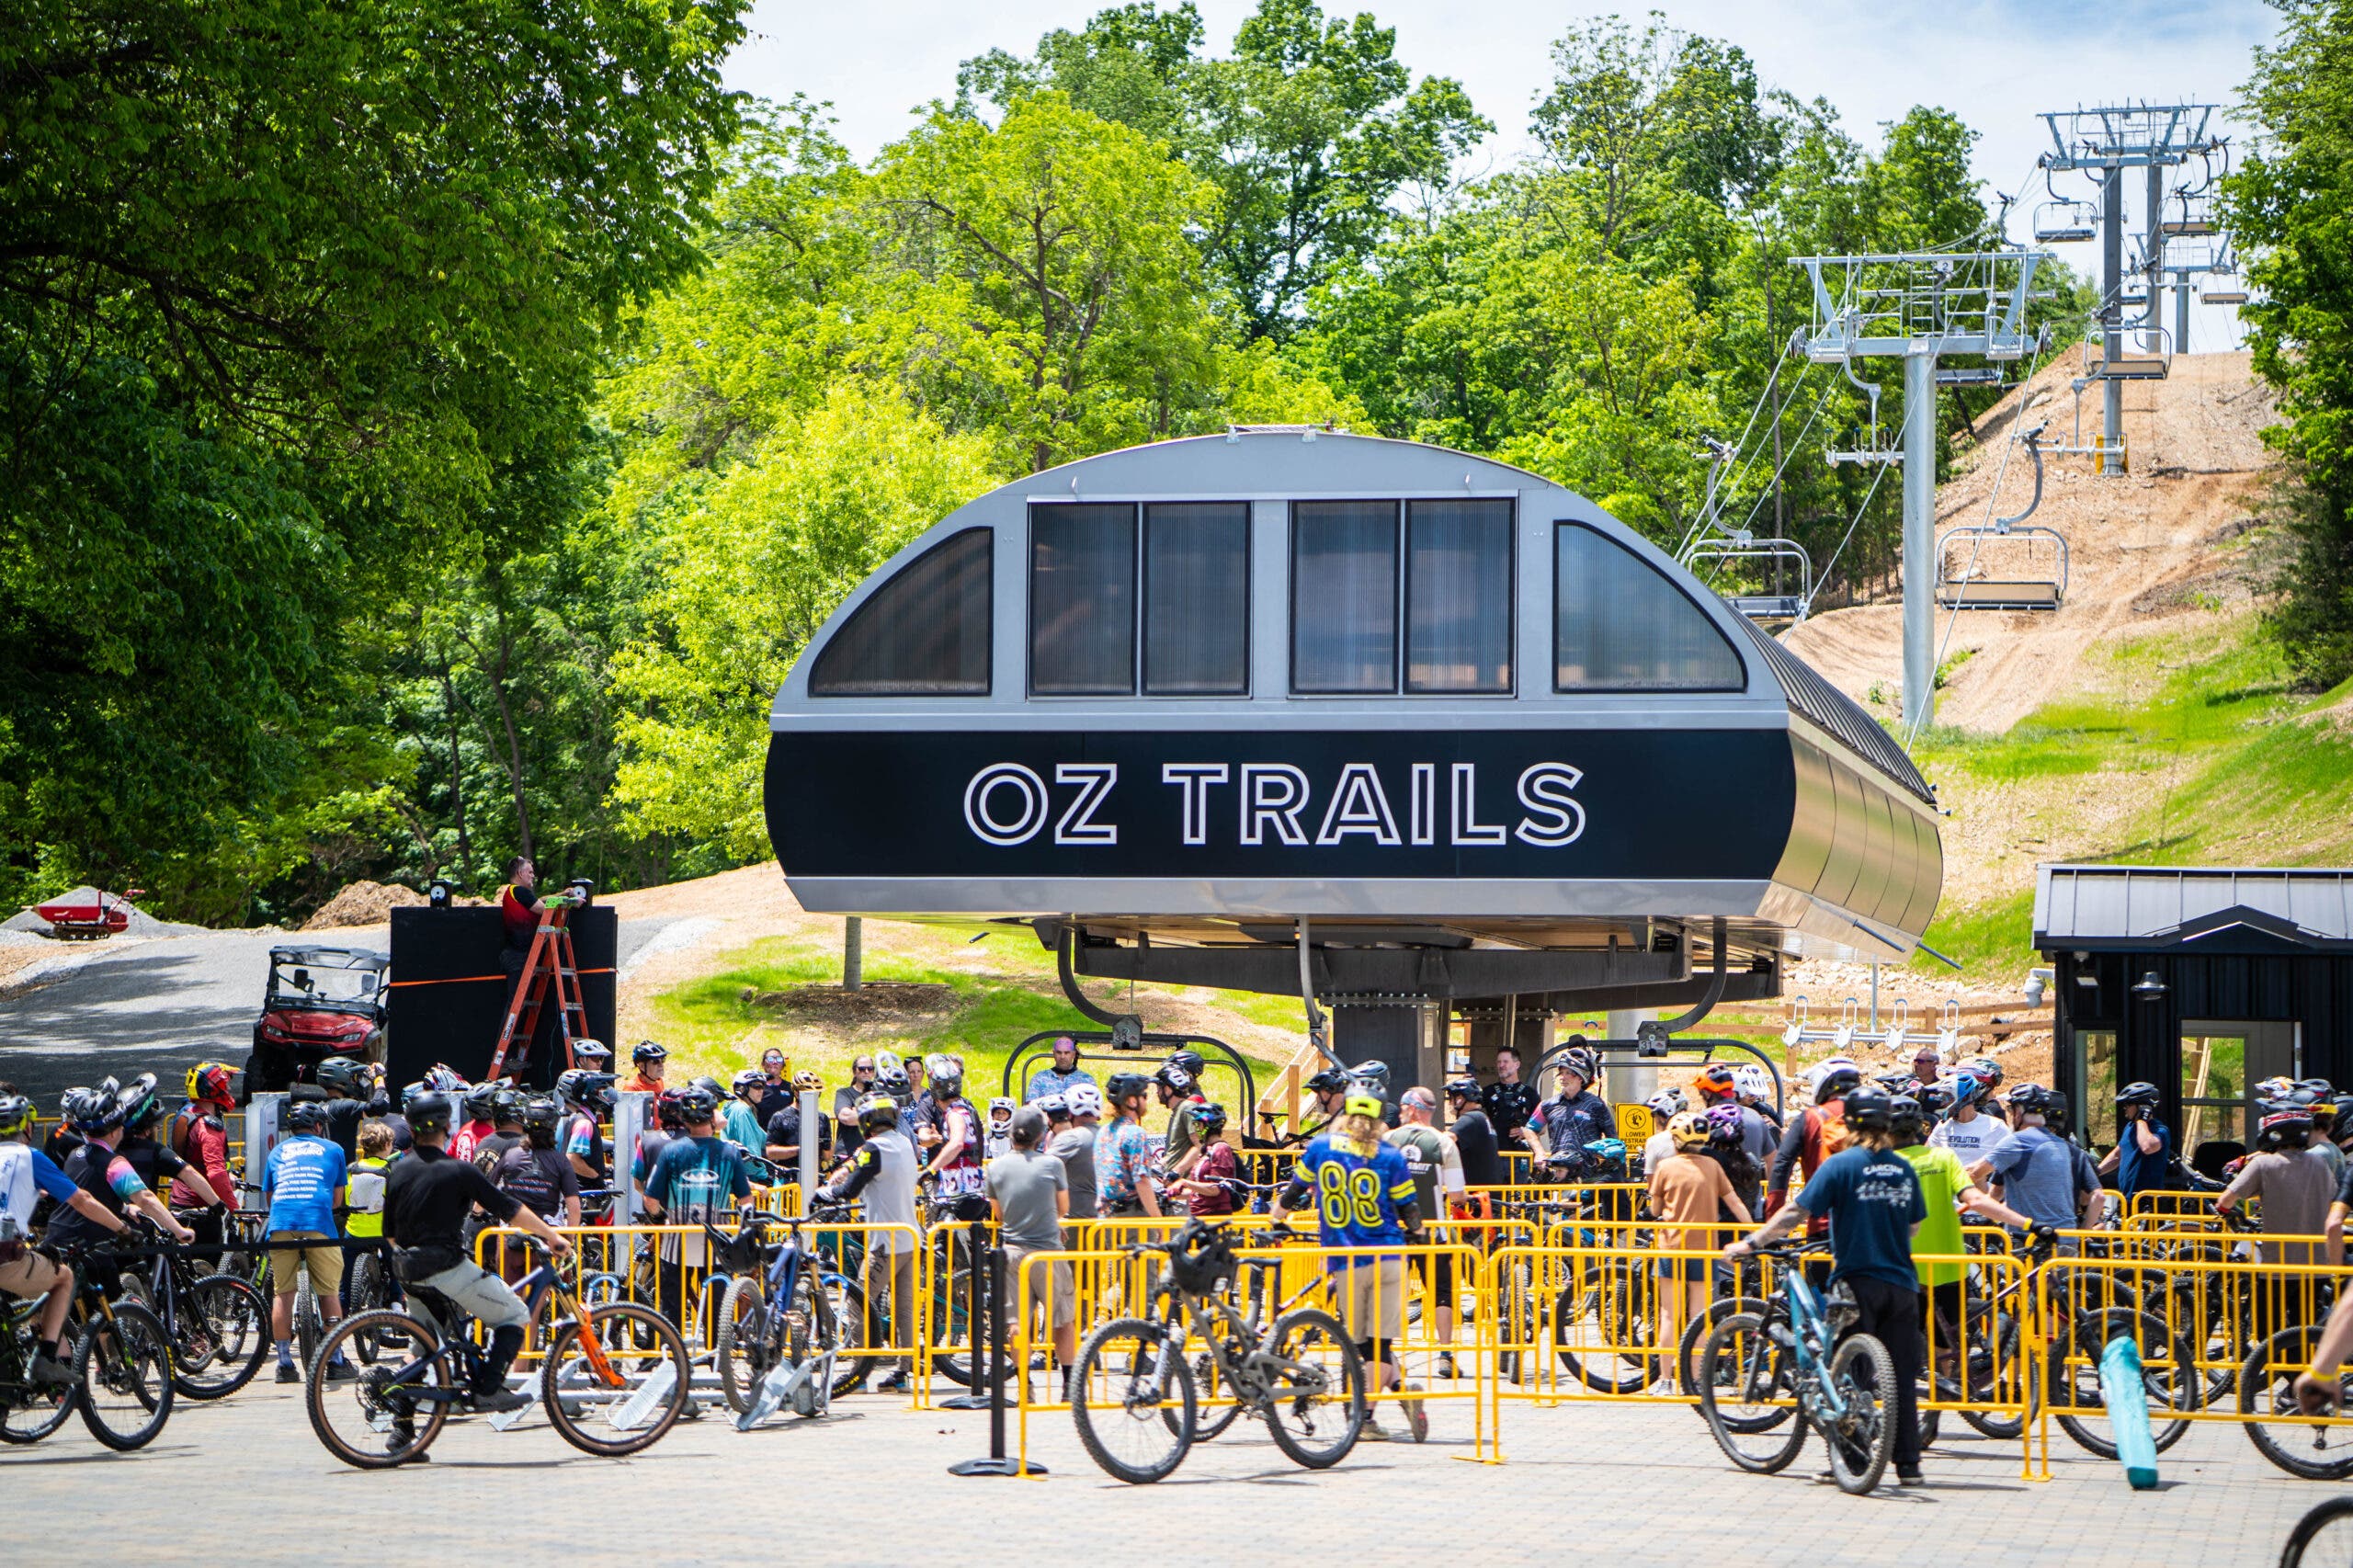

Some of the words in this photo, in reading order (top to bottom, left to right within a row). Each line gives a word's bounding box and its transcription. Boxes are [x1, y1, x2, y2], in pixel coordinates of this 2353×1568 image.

[963, 762, 1118, 846] OZ
[1162, 761, 1586, 847] TRAILS
[1641, 1040, 1652, 1050] 31
[1318, 1160, 1384, 1229] 88
